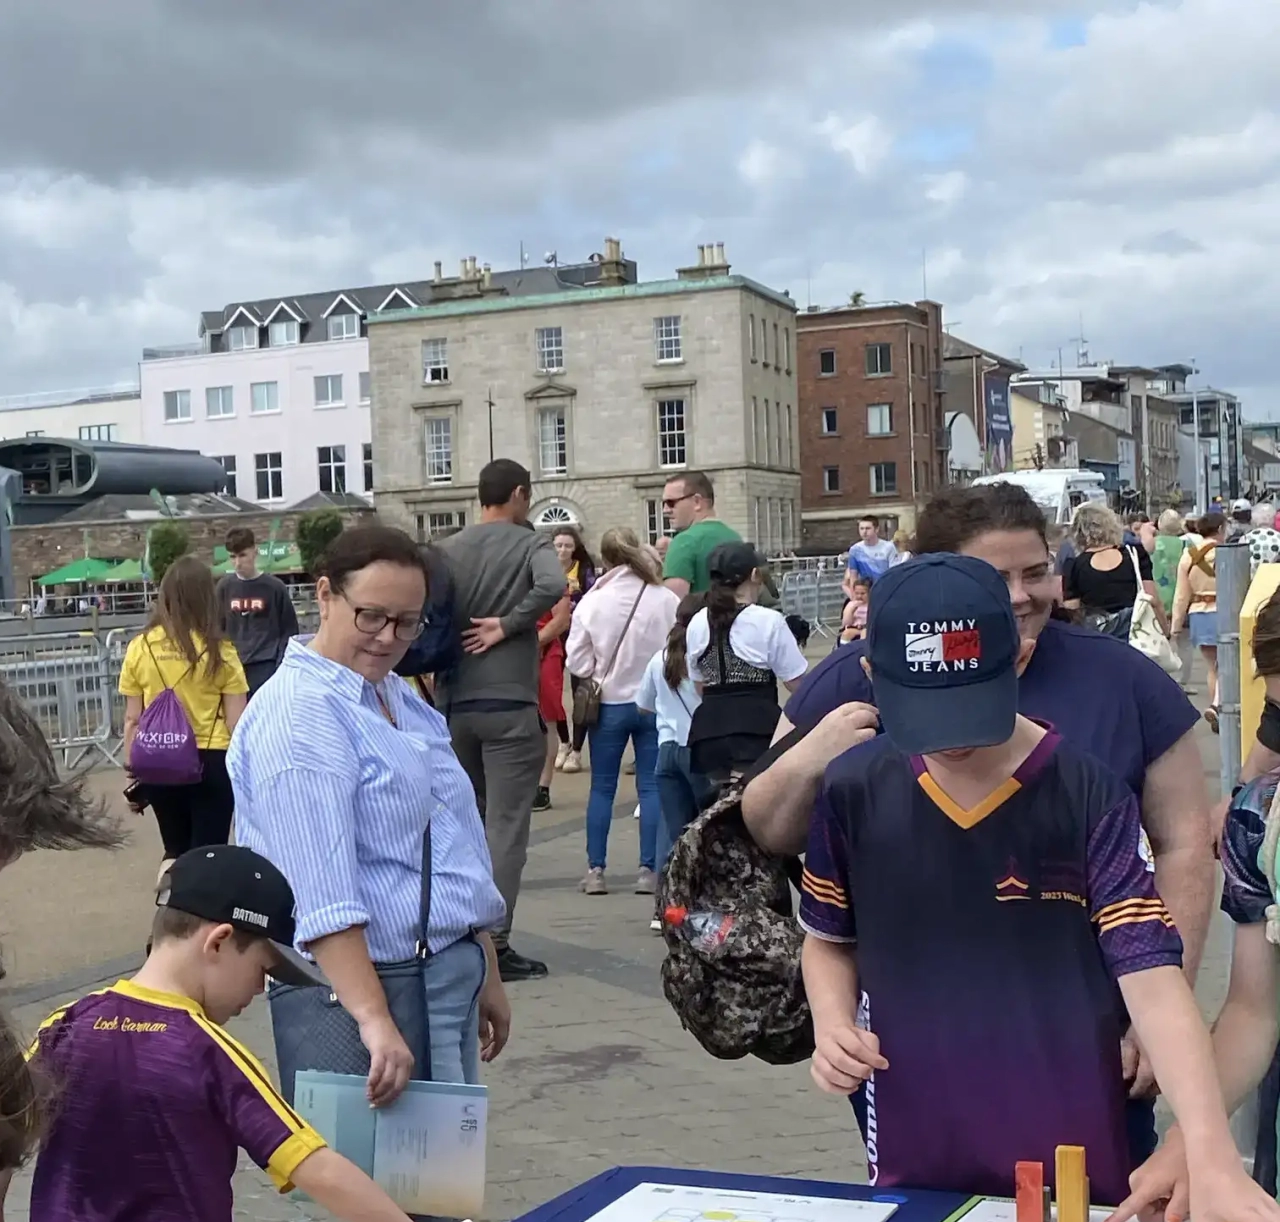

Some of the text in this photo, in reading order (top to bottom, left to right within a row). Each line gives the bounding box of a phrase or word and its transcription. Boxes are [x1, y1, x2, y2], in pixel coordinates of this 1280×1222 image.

[230, 599, 263, 610] AIR
[907, 618, 976, 634] TOMMY
[909, 657, 979, 673] JEANS
[232, 907, 269, 929] BATMAN
[93, 1015, 168, 1033] Loch Garman
